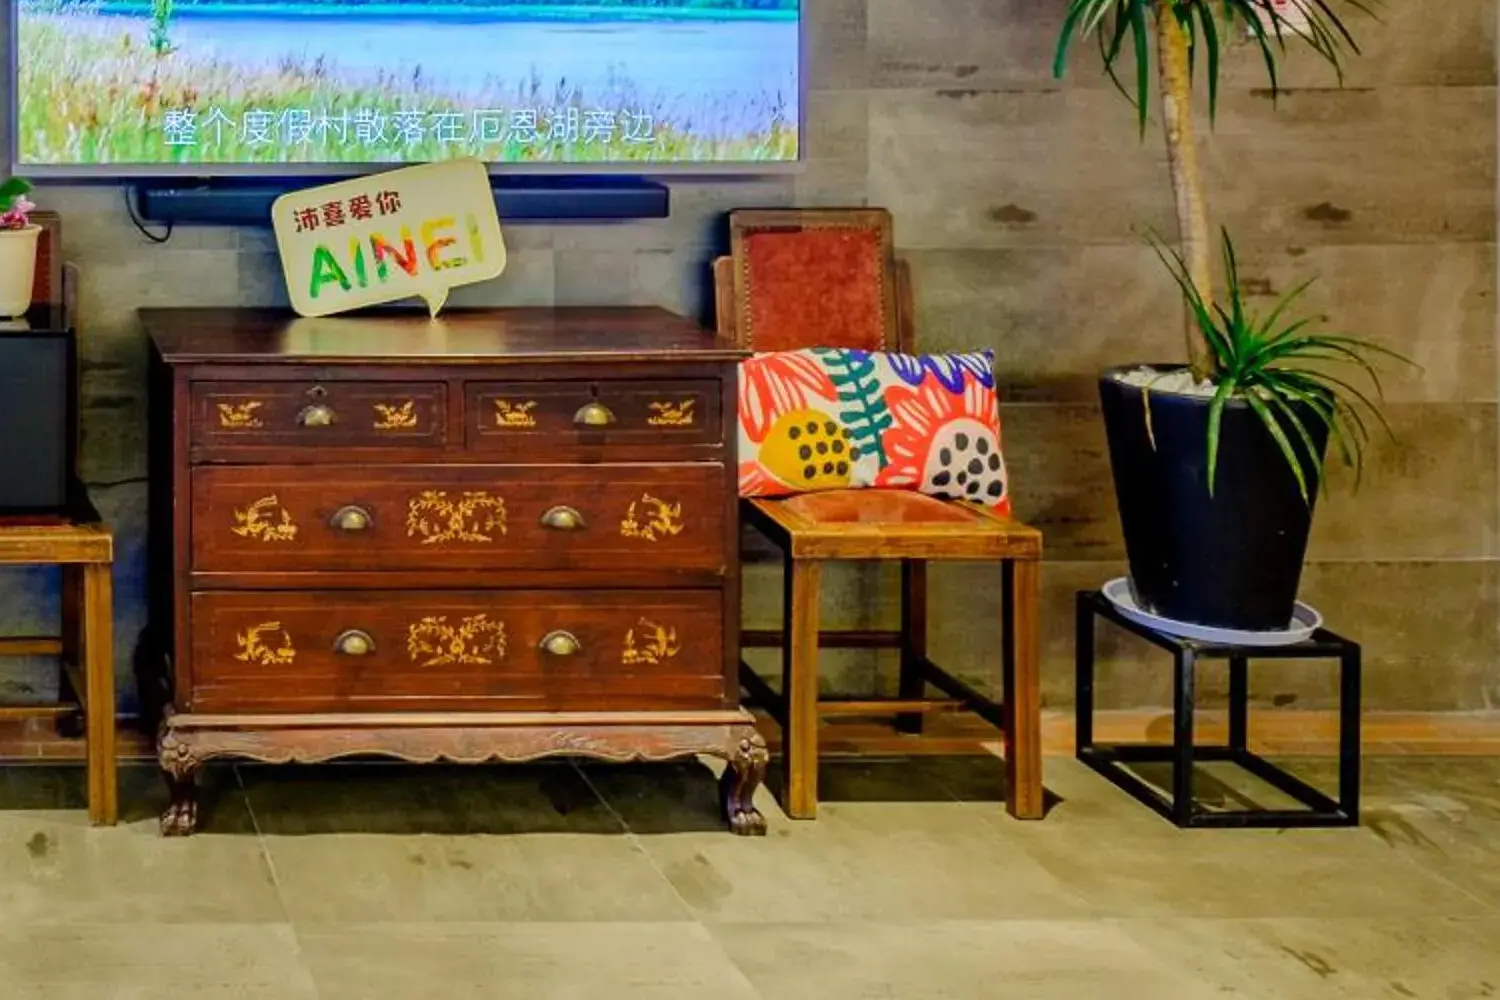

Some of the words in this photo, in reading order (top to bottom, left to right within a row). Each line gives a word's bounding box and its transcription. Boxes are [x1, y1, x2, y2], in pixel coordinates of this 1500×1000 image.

[163, 107, 656, 146] 整个度假村散落在厄恩湖旁边
[293, 190, 403, 233] 沛喜爱你
